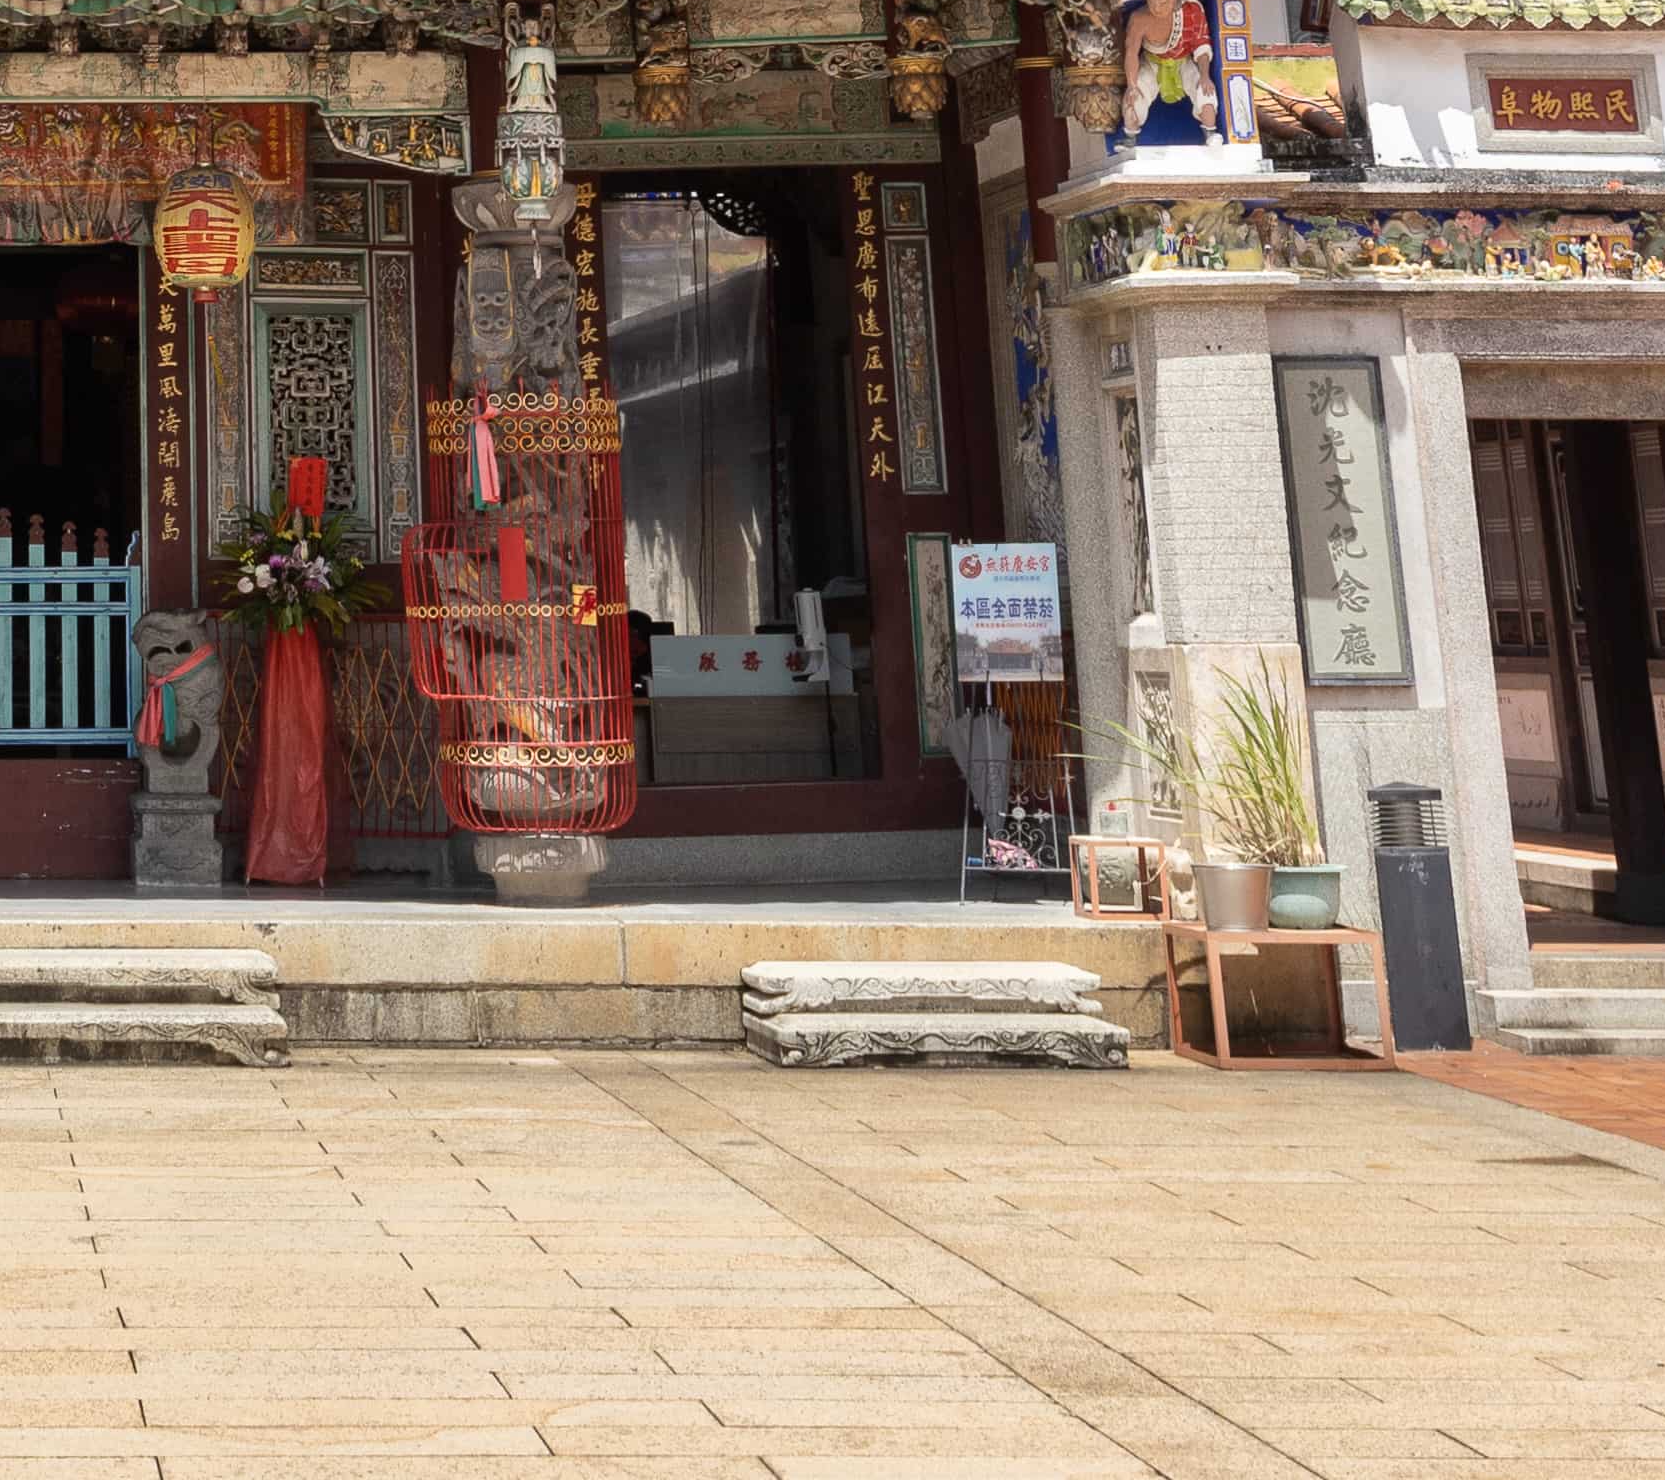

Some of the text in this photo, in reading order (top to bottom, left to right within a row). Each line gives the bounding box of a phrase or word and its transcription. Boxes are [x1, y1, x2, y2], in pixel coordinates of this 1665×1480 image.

[1306, 376, 1377, 667] 沈光文紀念廳
